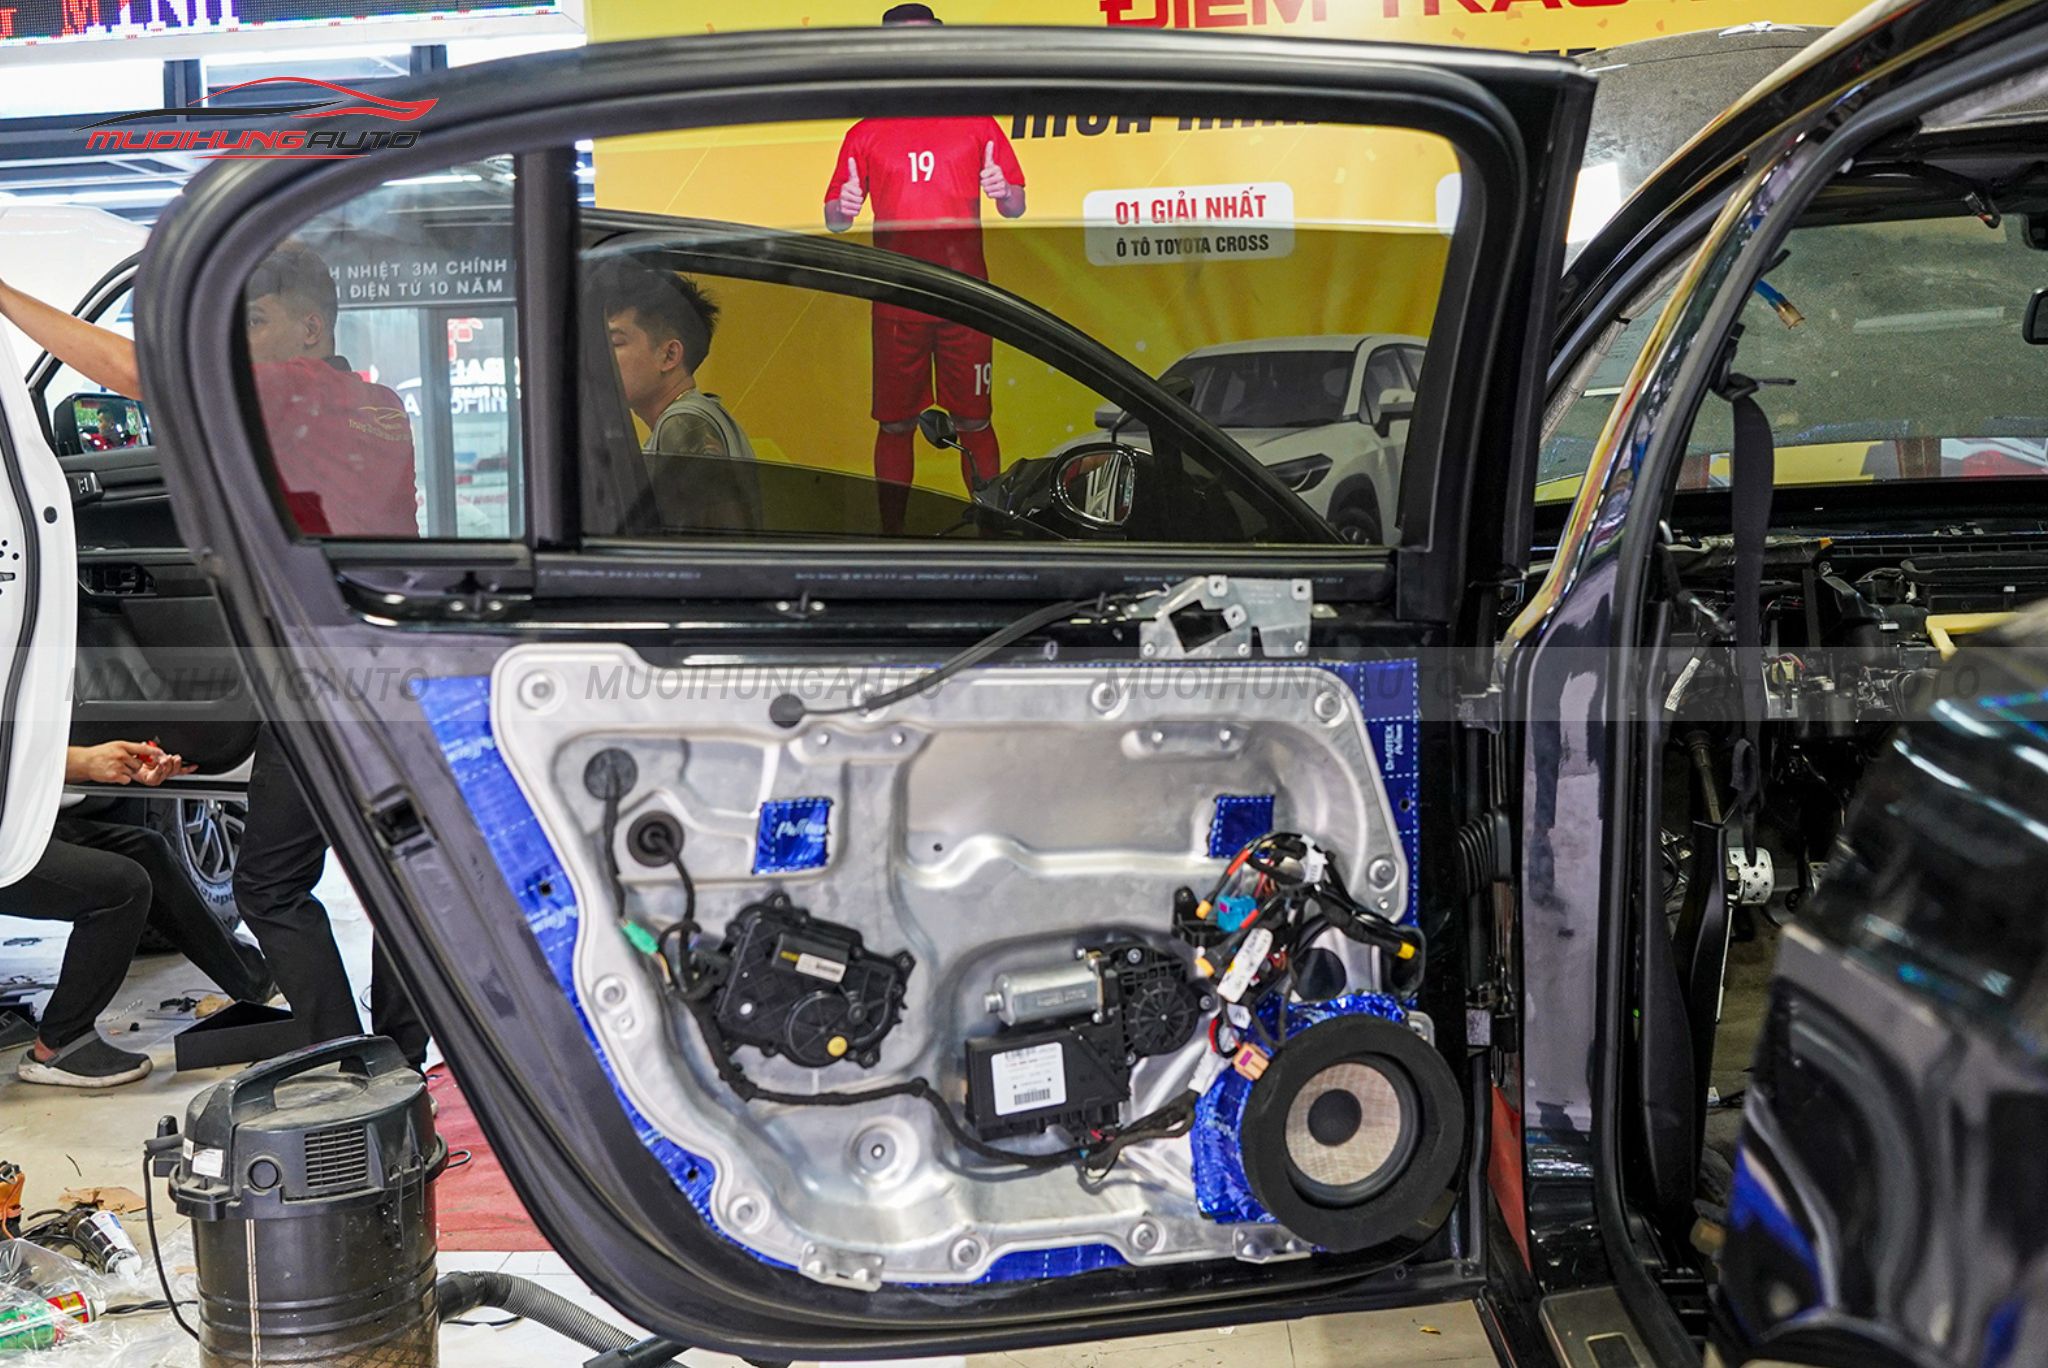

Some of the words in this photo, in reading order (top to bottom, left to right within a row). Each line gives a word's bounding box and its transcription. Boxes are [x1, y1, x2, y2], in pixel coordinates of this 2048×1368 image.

[907, 151, 935, 182] 19
[1115, 201, 1140, 224] 01
[1151, 190, 1197, 224] GIẢI
[1206, 186, 1267, 219] NHẤT
[1116, 237, 1127, 257] Ô
[1131, 236, 1151, 257] TÔ
[1154, 235, 1211, 256] TOYOTA
[1216, 234, 1269, 253] CROSS
[348, 261, 401, 280] NHIỆT
[412, 262, 438, 276] 3M
[446, 257, 508, 275] CHÍNH
[350, 281, 390, 300] ĐIỆN
[429, 281, 449, 295] 10
[457, 277, 503, 294] NĂM
[974, 363, 992, 396] 19
